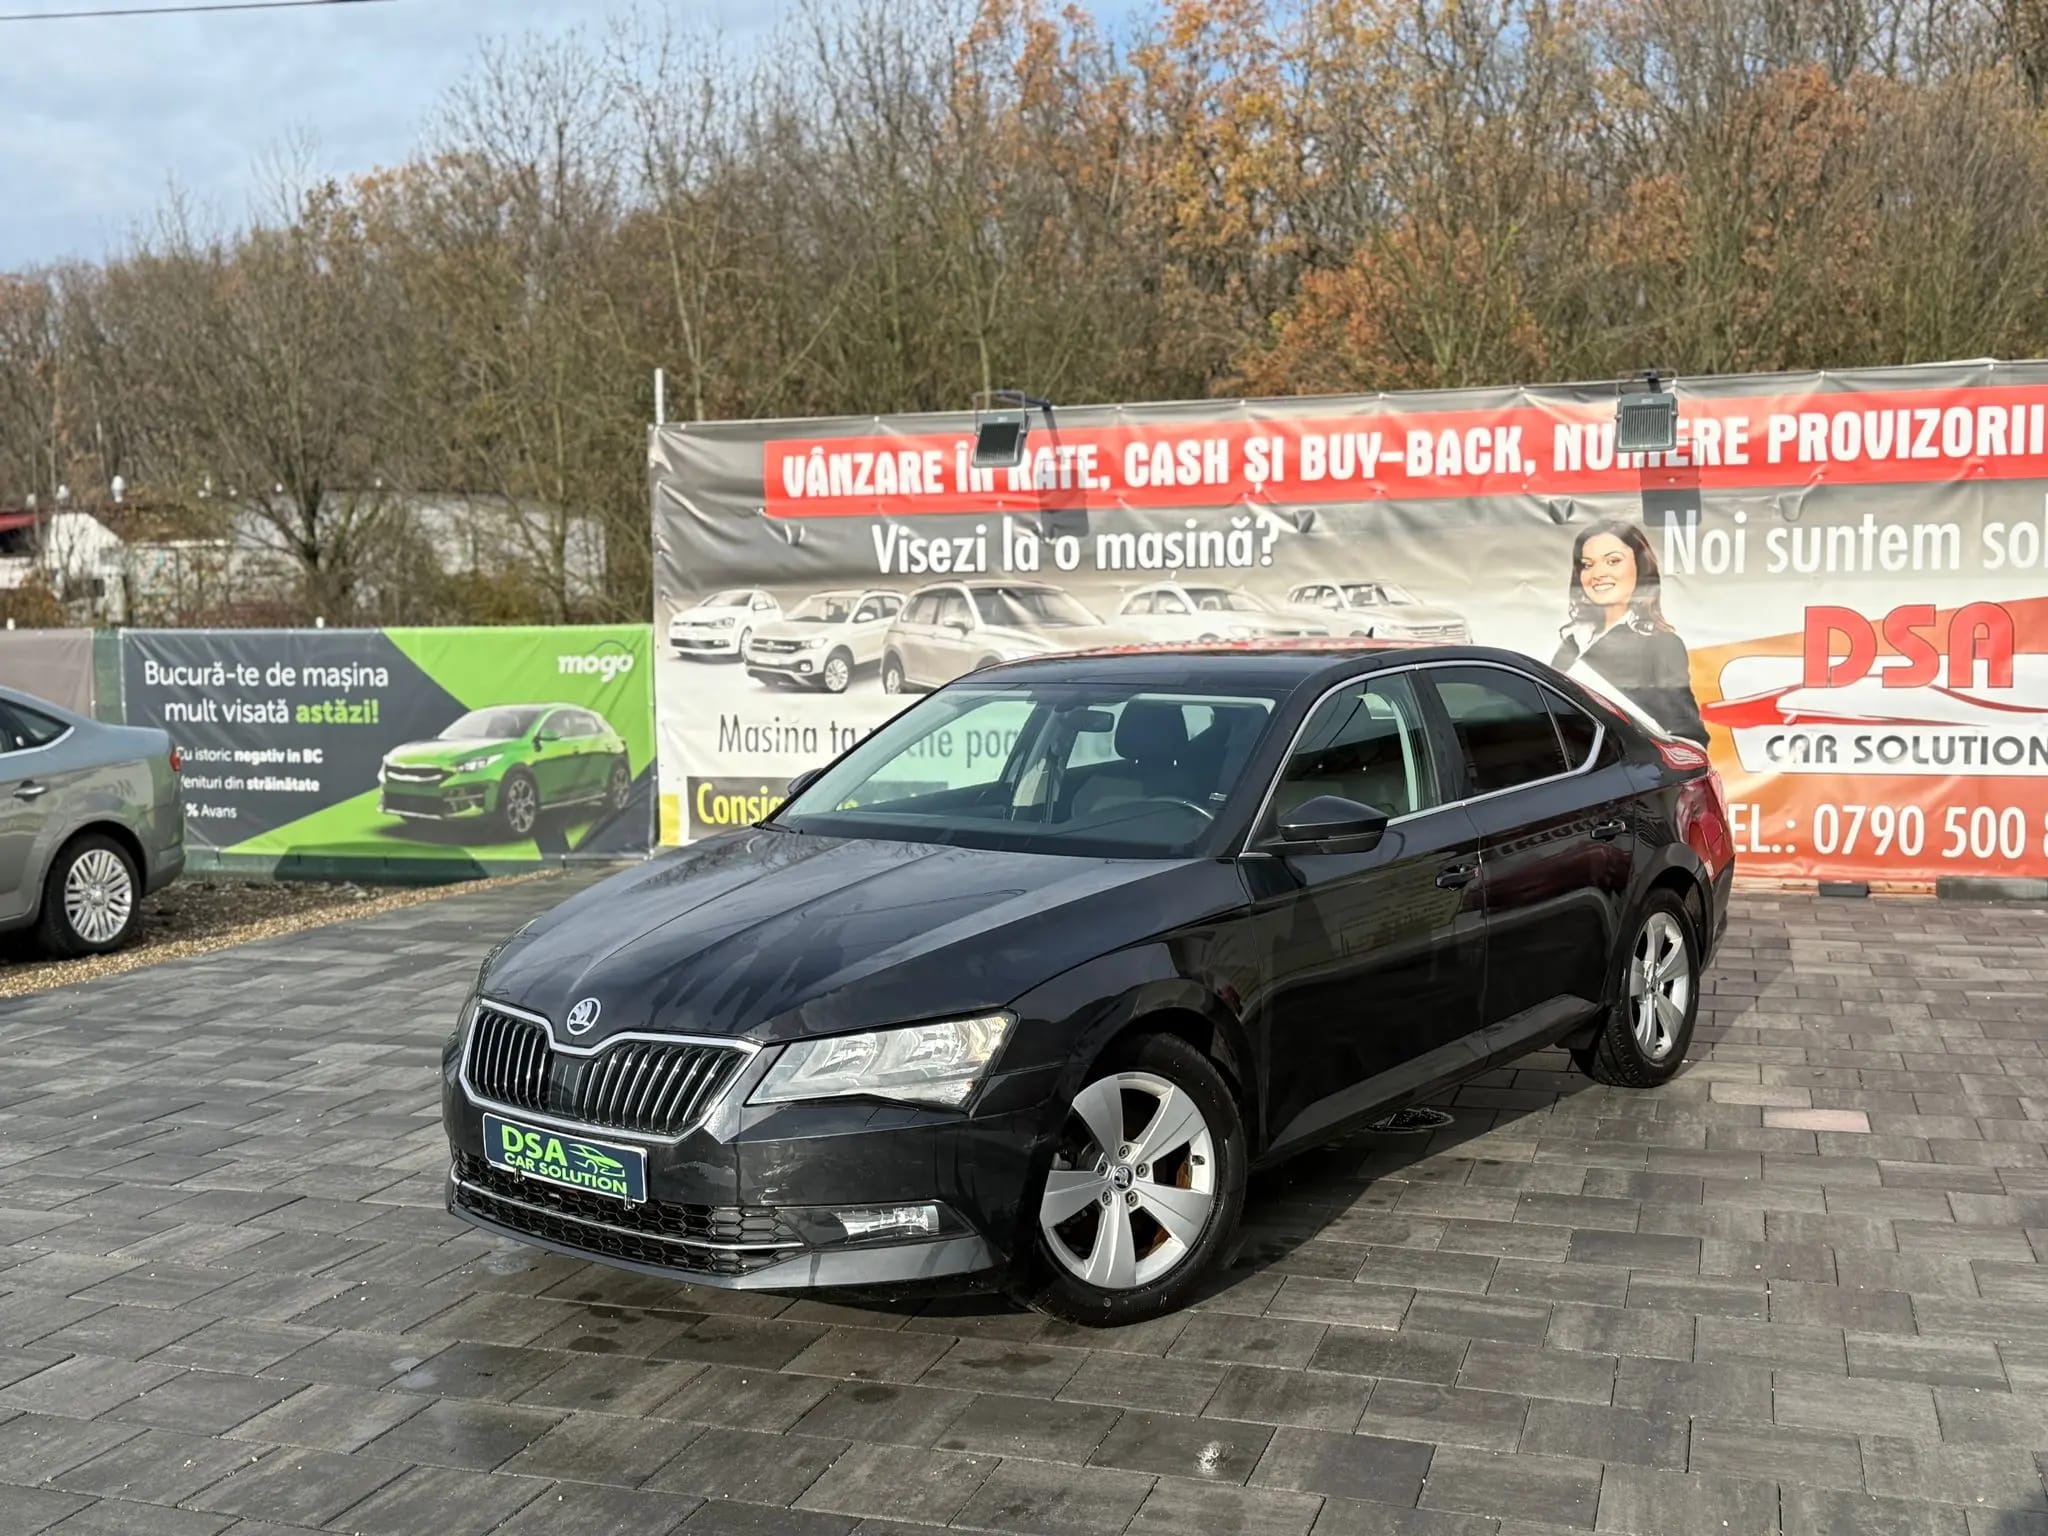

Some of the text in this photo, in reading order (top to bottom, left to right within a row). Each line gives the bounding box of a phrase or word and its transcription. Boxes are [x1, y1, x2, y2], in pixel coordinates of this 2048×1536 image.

[783, 446, 945, 498] VÂNZARE
[1124, 439, 1229, 487] CASH
[1244, 436, 1284, 494] ȘI
[1767, 404, 2045, 464] PROVIZORII
[871, 523, 987, 574] Visezi
[1003, 516, 1039, 572] la
[1055, 535, 1080, 572] o
[1664, 510, 1747, 576] Noi
[1766, 513, 1960, 575] suntem
[1803, 601, 2015, 689] DSA
[144, 661, 389, 692] Bucură-te de mașina
[557, 655, 634, 683] mogo
[165, 698, 380, 724] mult visată astăzi!
[829, 720, 856, 754] ta
[1765, 735, 2048, 766] CAR SOLUTION
[176, 747, 193, 761] Cu
[195, 747, 231, 762] istoric
[234, 748, 285, 766] negativ
[302, 749, 324, 764] BC
[224, 776, 245, 790] din
[201, 804, 238, 818] Avans
[697, 783, 786, 824] Consi
[1727, 803, 1797, 853] EL.:
[1813, 803, 1925, 857] 0790
[1941, 806, 2026, 859] 500
[502, 1125, 568, 1166] DSA
[504, 1152, 628, 1194] CAR SOLUTION
